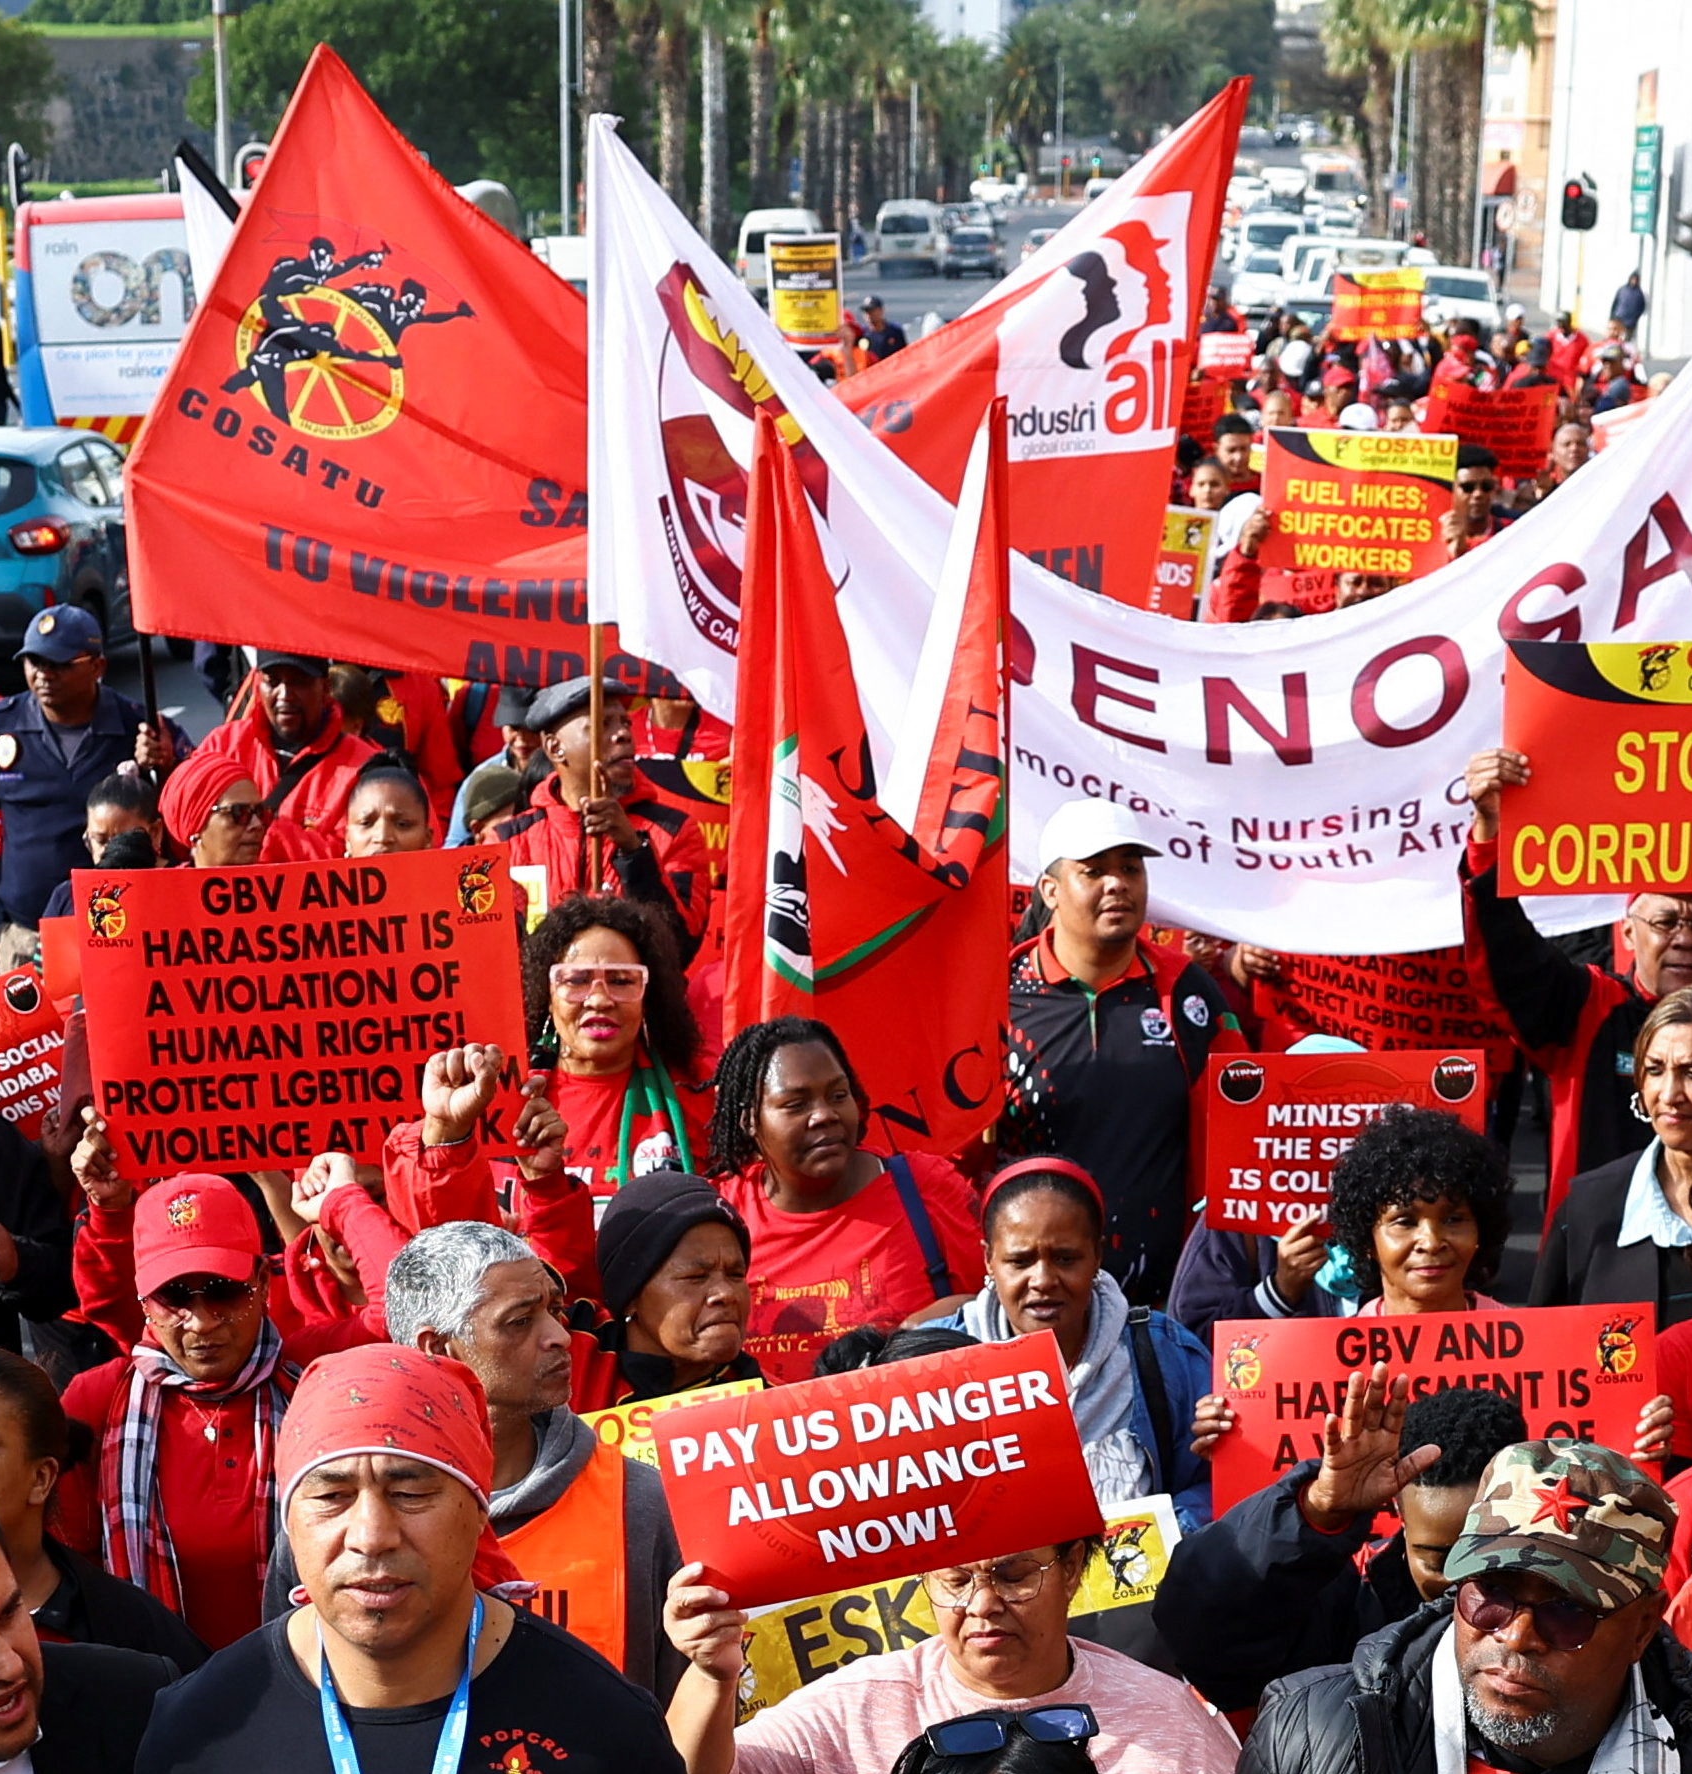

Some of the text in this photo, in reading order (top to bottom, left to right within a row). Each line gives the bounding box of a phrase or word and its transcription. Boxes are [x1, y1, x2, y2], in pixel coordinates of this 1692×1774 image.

[71, 247, 199, 329] on
[178, 387, 385, 510] COSATU
[1021, 436, 1096, 461] global union
[1357, 436, 1456, 457] COSATU
[1285, 478, 1429, 513] FUEL HIKES;
[1278, 510, 1432, 543] SUFFOCATES
[260, 522, 332, 582] TO
[1293, 544, 1413, 574] WORKERS
[686, 588, 713, 627] WE
[1230, 776, 1423, 848] Nursing
[1167, 834, 1374, 885] of South
[200, 865, 389, 916] GBV AND
[141, 909, 456, 968] HARASSMENT IS
[456, 913, 504, 927] COSATU
[86, 936, 134, 949] COSATU
[144, 960, 461, 1018] A VIOLATION OF
[1286, 955, 1378, 999] HUMAN
[1382, 982, 1479, 1017] RIGHTS!
[148, 1010, 467, 1067] HUMAN RIGHTS!
[1351, 1002, 1435, 1036] LGBTIQ
[100, 1073, 260, 1117] PROTECT
[268, 1059, 404, 1109] LGBTIQ
[124, 1111, 367, 1166] VIOLENCE AT
[1253, 1137, 1312, 1161] THE
[1228, 1168, 1262, 1192] IS
[1222, 1197, 1258, 1222] IN
[774, 1277, 850, 1302] NEGOTIATION
[1335, 1319, 1524, 1368] GBV AND
[1557, 1367, 1592, 1408] IS
[1594, 1372, 1644, 1385] COSATU
[668, 1423, 759, 1477] PAY
[772, 1409, 840, 1458] US
[849, 1369, 1060, 1433] DANGER
[1272, 1433, 1297, 1472] A
[725, 1433, 1027, 1528] ALLOWANCE
[816, 1503, 959, 1563] NOW!
[1111, 1582, 1160, 1601] COSATU
[478, 1728, 570, 1762] POPCRU
